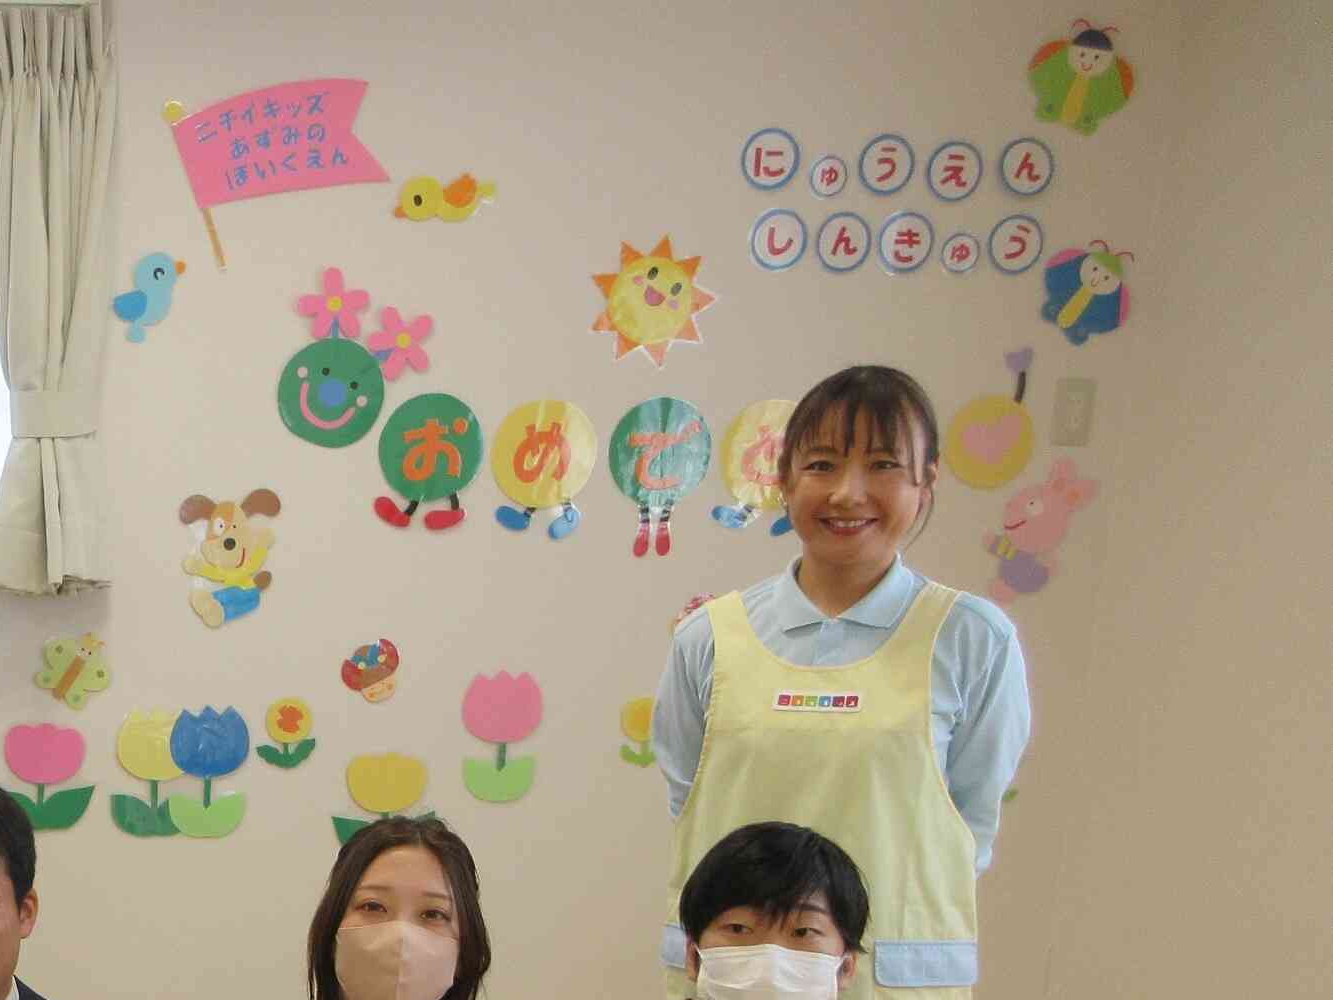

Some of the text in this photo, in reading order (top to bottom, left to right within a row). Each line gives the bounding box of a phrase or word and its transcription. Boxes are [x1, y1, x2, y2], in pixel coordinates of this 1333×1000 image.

[195, 92, 331, 143] ニチイキッズ
[230, 123, 326, 159] あずみの
[225, 147, 348, 190] ほいくえん
[753, 147, 1041, 188] にゅうえん
[767, 224, 1031, 263] しんきゅう
